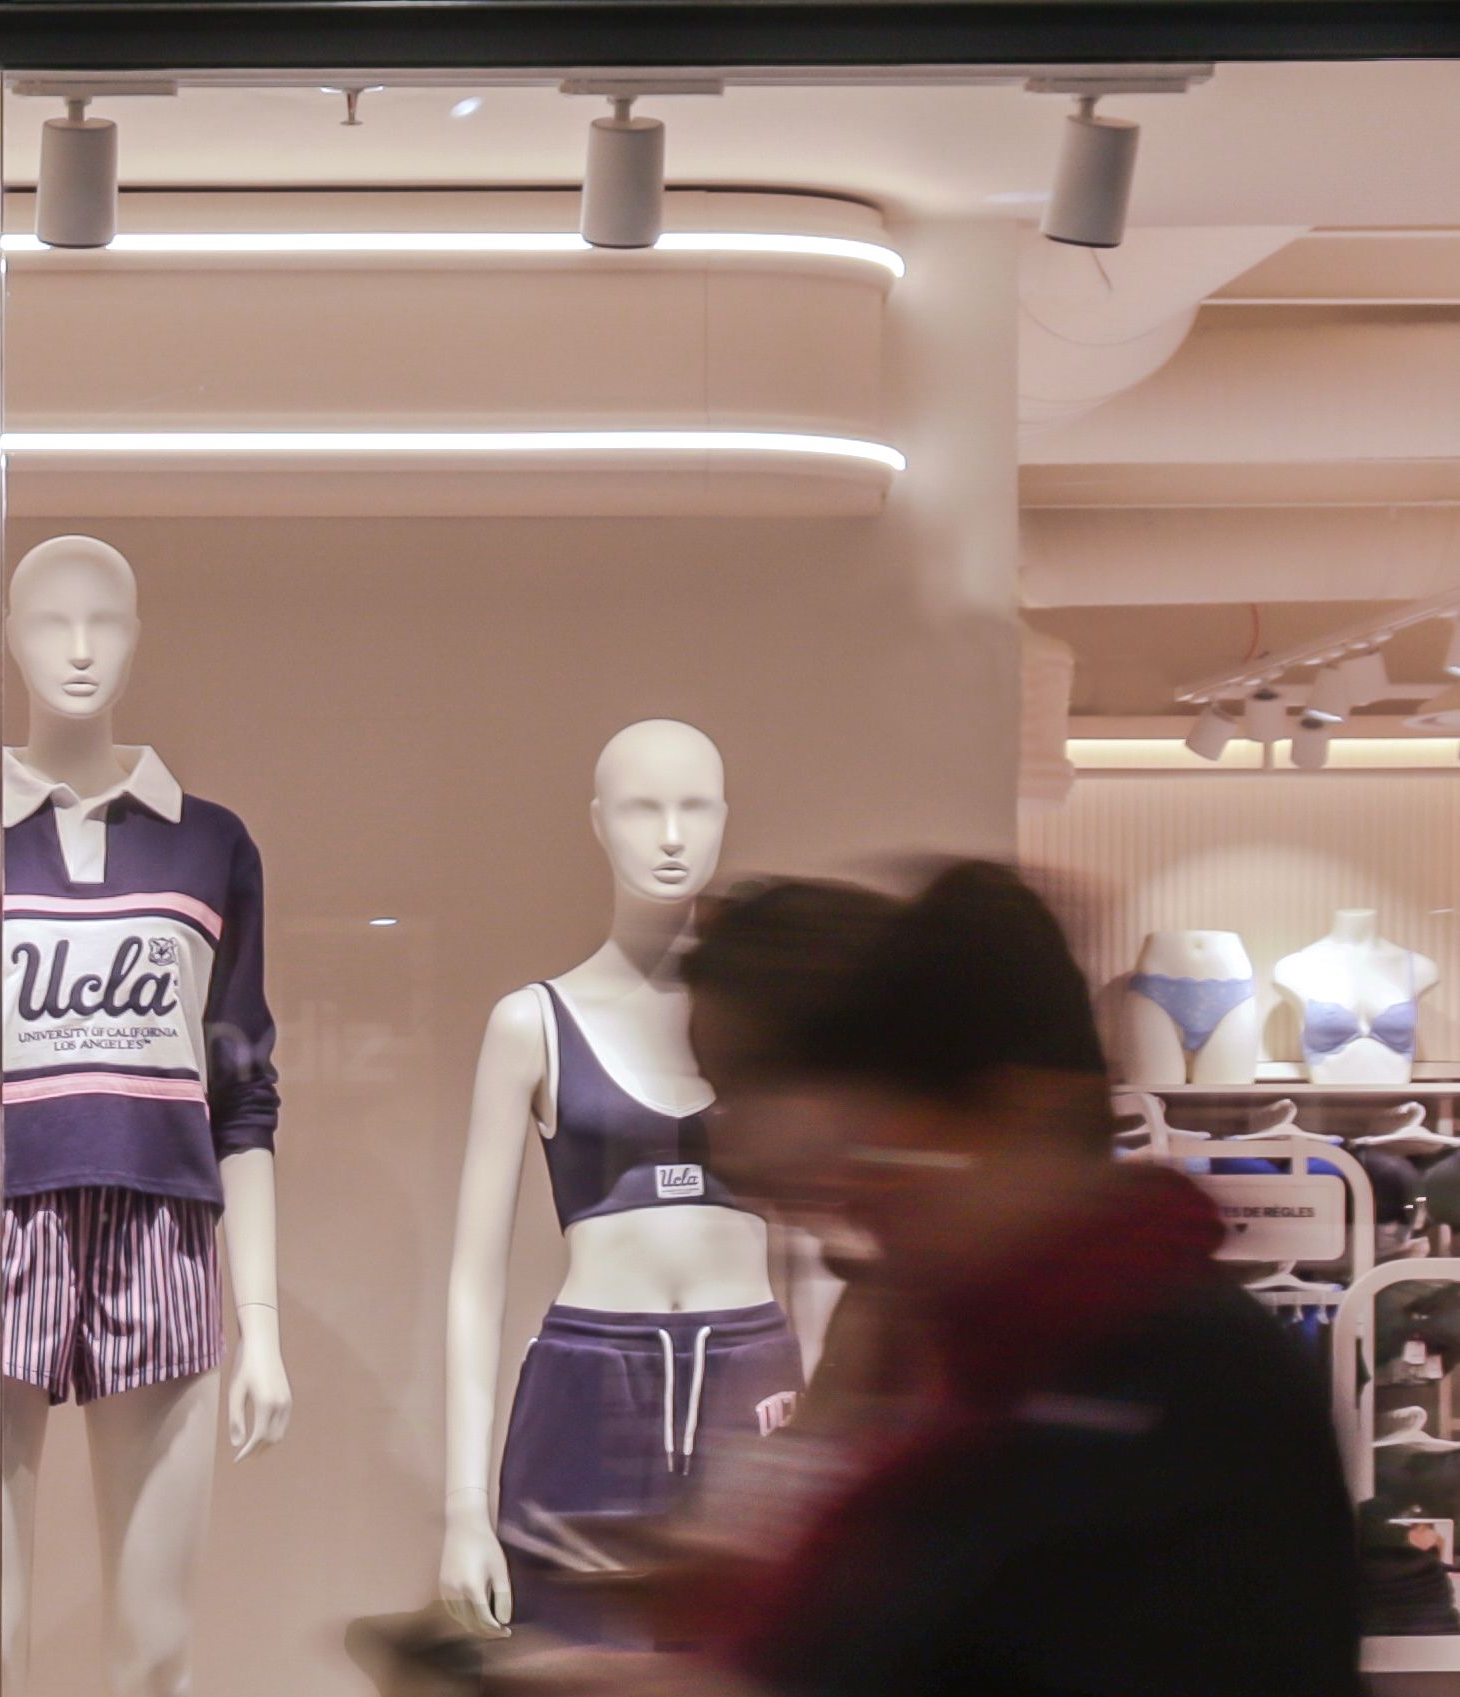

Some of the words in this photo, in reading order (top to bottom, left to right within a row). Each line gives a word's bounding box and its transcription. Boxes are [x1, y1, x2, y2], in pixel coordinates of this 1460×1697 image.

[11, 936, 178, 1021] Ucla
[18, 1028, 89, 1043] UNIVERSITY
[107, 1027, 178, 1038] CALIFORNIA
[54, 1041, 77, 1051] LOS
[660, 1167, 699, 1187] Ucla
[755, 1391, 797, 1437] UC
